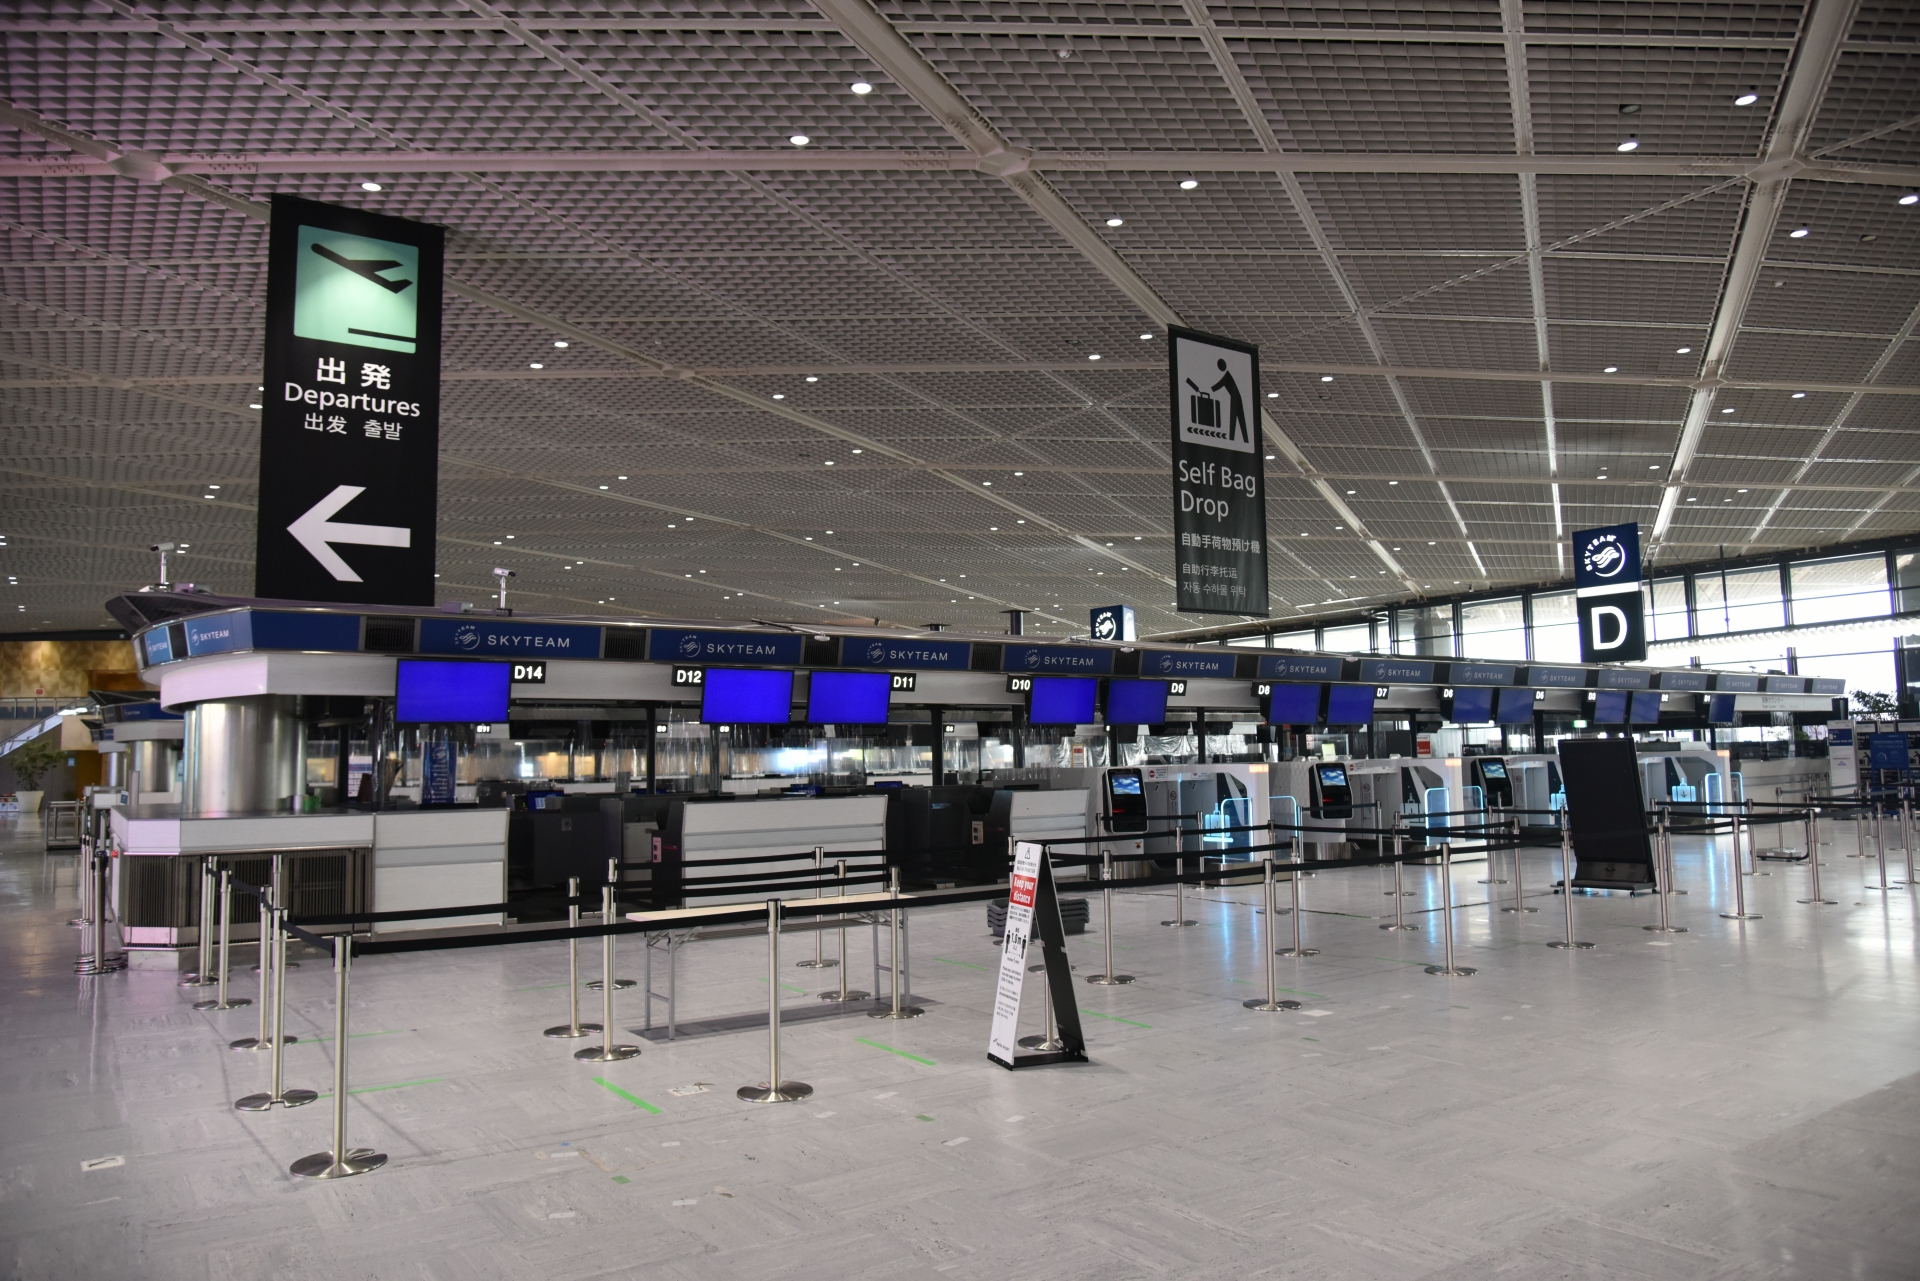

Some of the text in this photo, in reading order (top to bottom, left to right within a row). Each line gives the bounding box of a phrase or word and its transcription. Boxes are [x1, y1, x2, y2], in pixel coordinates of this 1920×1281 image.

[316, 357, 391, 390] 出発
[284, 382, 421, 417] Departures
[304, 412, 403, 441] 出发 출발
[1178, 459, 1256, 498] Self Bag
[1180, 489, 1229, 522] Drop
[1181, 532, 1261, 554] 自動手荷物預け機
[1584, 534, 1617, 572] SKYTEAM
[1182, 563, 1238, 579] 自助行李托运
[1183, 581, 1246, 598] 자동 수하물 위탁
[1591, 605, 1628, 651] D
[200, 629, 230, 641] SKYTEAM
[454, 625, 476, 645] SKYTEAM
[487, 634, 570, 648] SKYTEAM
[706, 643, 776, 655] SKYTEAM
[889, 650, 948, 661] SKYTEAM
[1044, 656, 1094, 666] SKYTEAM
[1175, 661, 1219, 670] SKYTEAM
[514, 665, 543, 679] D14
[676, 669, 702, 683] D12
[1289, 665, 1327, 674] SKYTEAM
[1387, 668, 1421, 677] SKYTEAM
[1473, 671, 1503, 679] SKYTEAM
[893, 676, 913, 688] D11
[1011, 679, 1031, 690] D10
[1549, 674, 1576, 682] SKYTEAM
[1617, 676, 1641, 684] SKYTEAM
[1171, 683, 1184, 693] D9
[1258, 685, 1270, 695] D8
[1376, 687, 1388, 697] D7
[1443, 689, 1454, 698] D6
[1013, 876, 1035, 891] Keep your
[1013, 890, 1031, 904] distance
